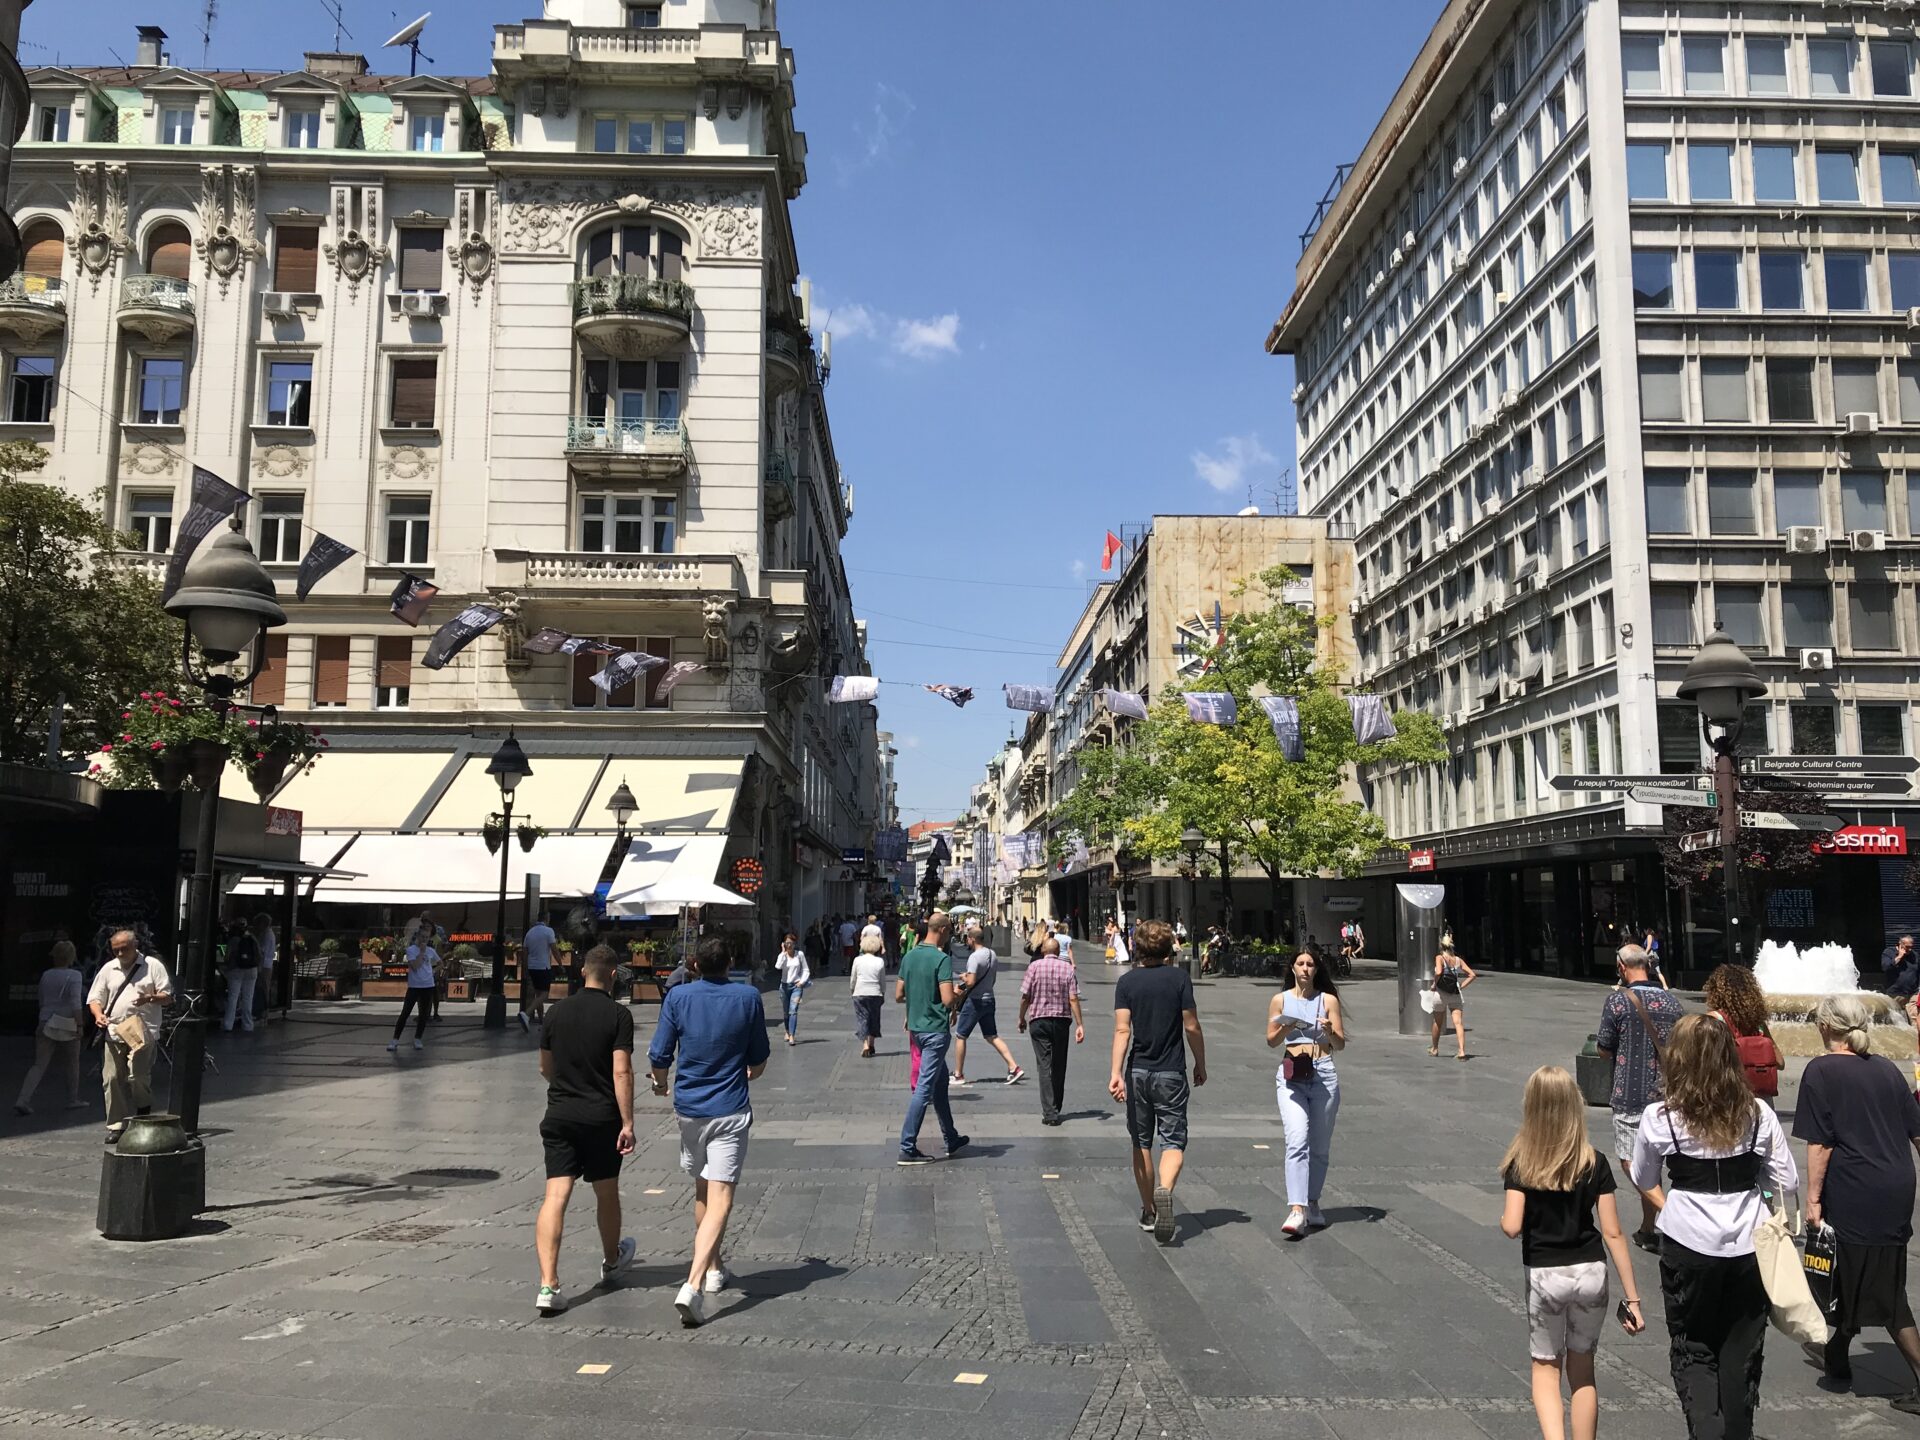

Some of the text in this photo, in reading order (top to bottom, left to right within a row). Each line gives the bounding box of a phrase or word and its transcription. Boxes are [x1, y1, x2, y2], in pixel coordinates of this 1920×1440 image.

[1764, 760, 1863, 769] Belgrade Cultural Centre
[1573, 779, 1607, 788] Галерија
[1807, 780, 1845, 789] bohemian
[1846, 782, 1875, 790] quarter
[1763, 816, 1823, 828] Republic Square
[1803, 1254, 1831, 1272] TRON
